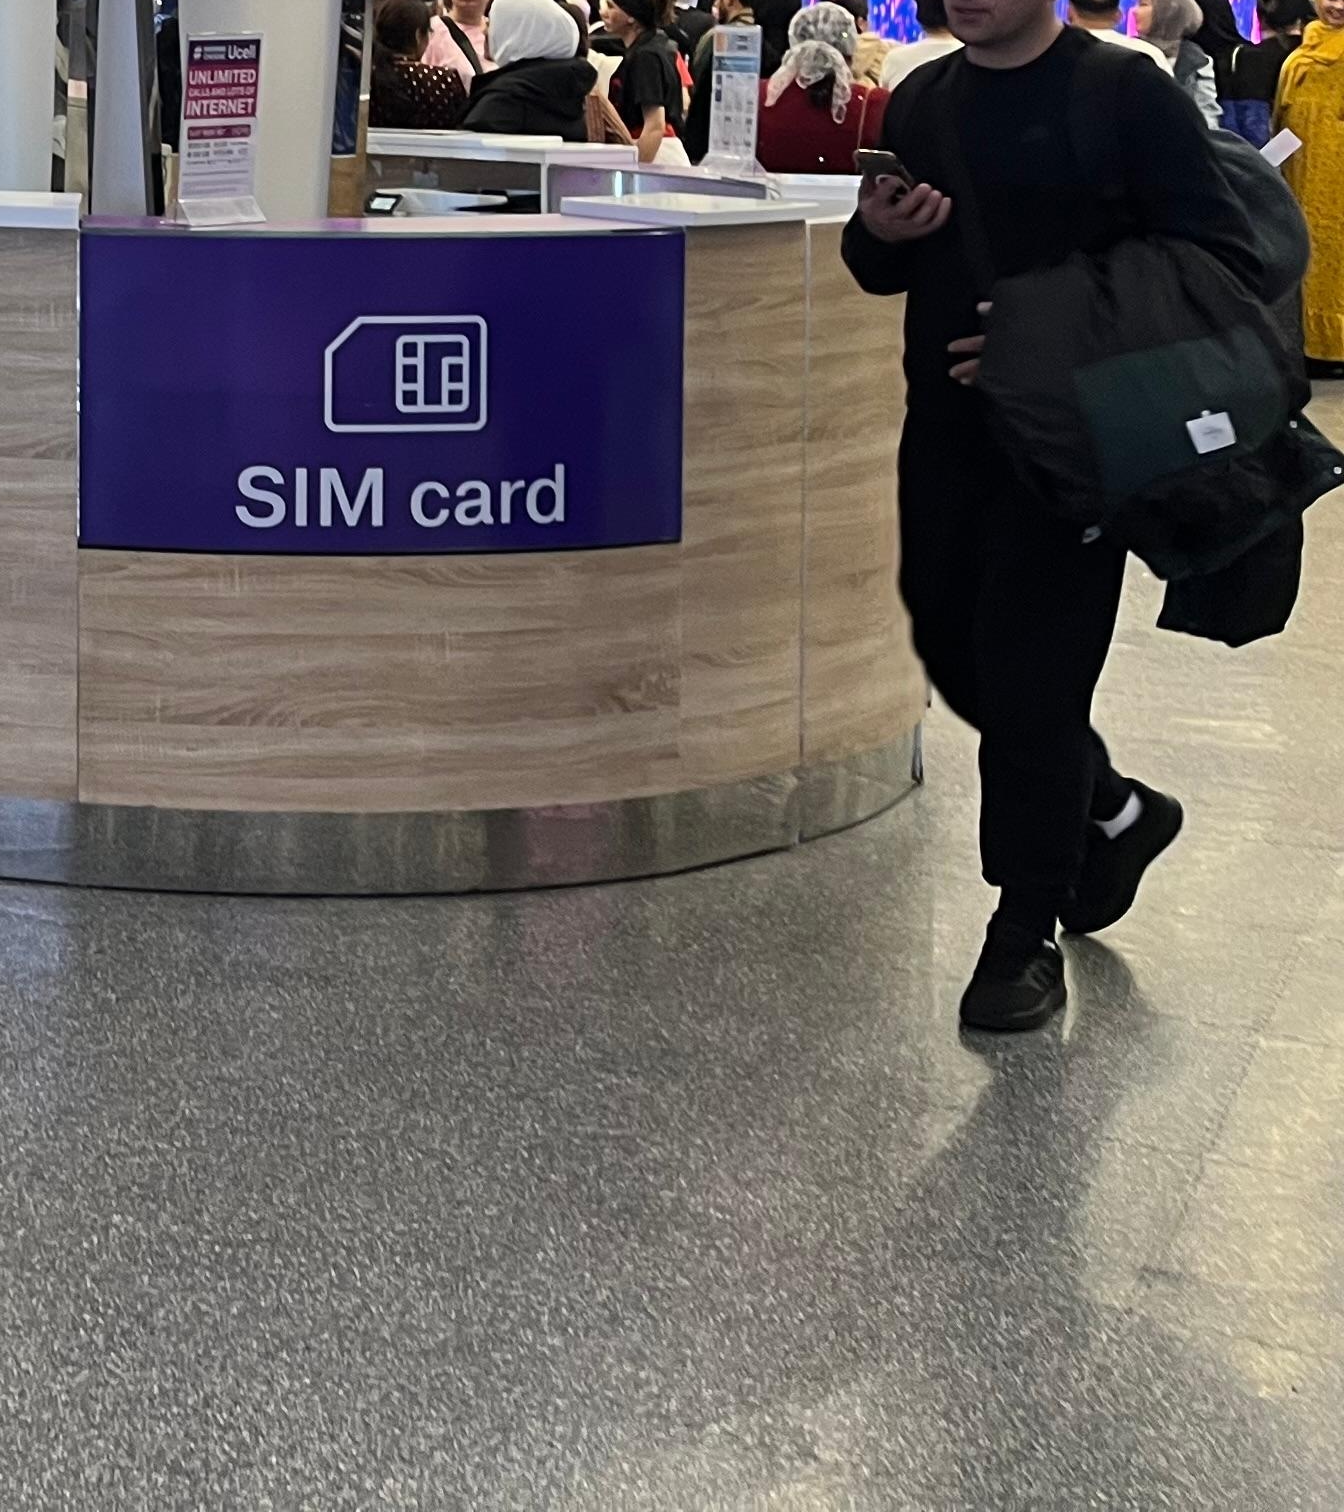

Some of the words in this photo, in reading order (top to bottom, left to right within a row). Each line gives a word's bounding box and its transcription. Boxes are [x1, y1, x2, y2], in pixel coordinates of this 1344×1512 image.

[227, 44, 257, 60] Ucell
[188, 69, 257, 85] UNLIMITED
[186, 98, 255, 116] INTERNET
[235, 464, 385, 529] SIM
[410, 462, 567, 528] card
